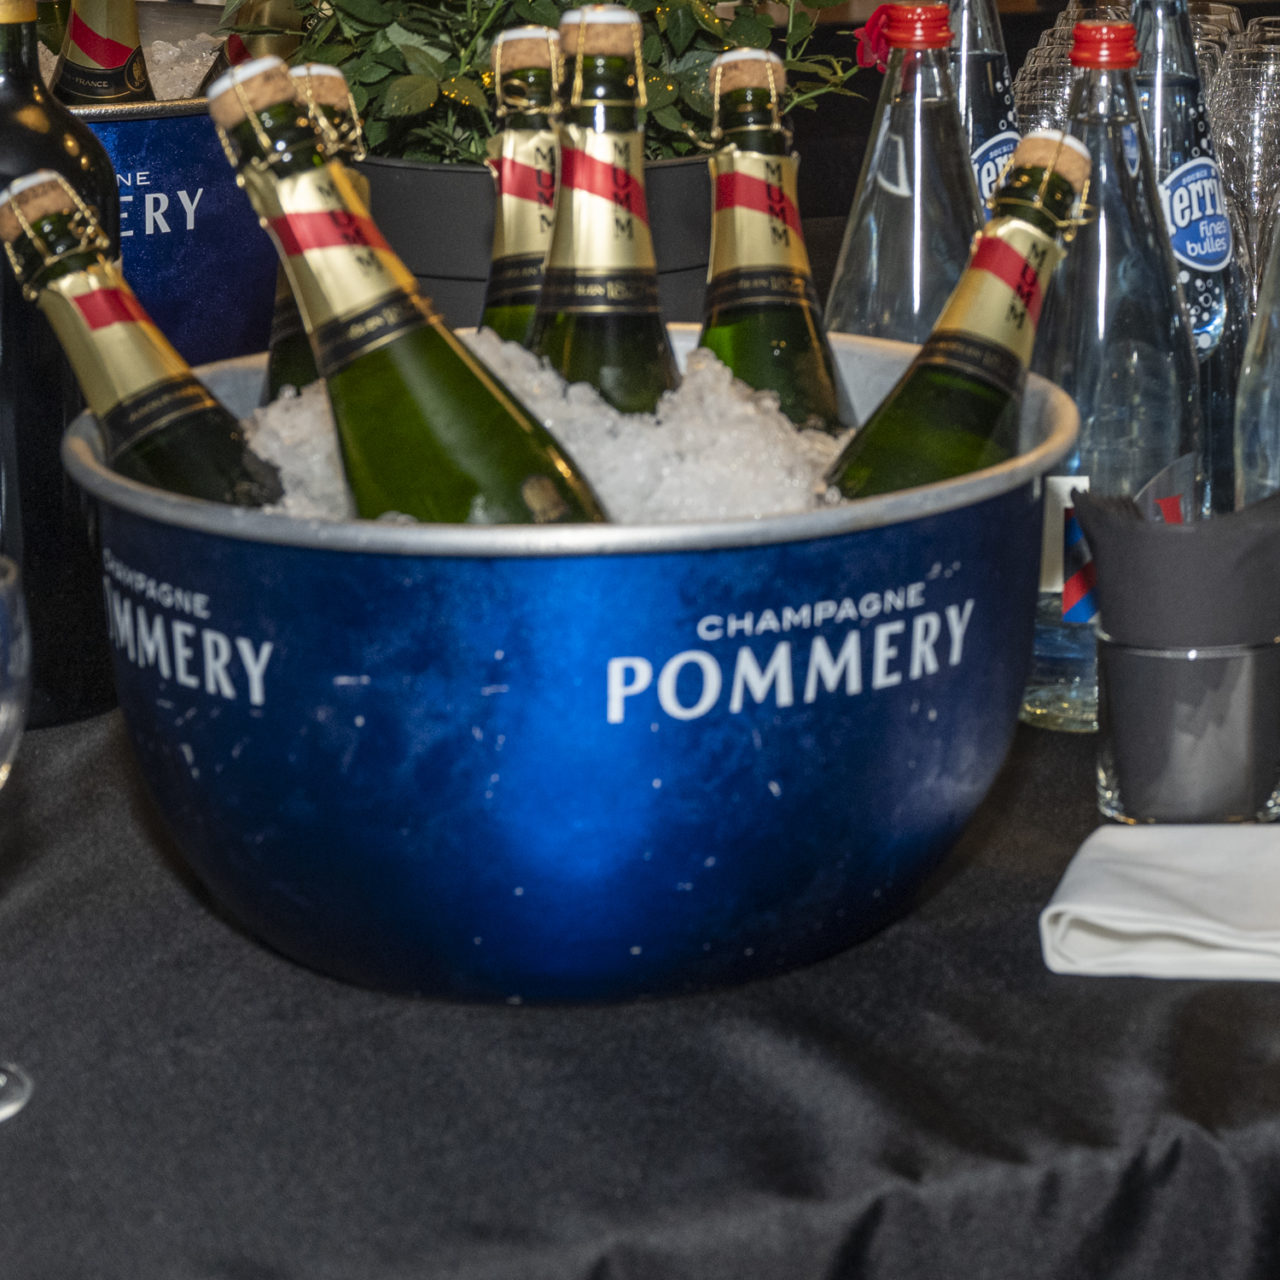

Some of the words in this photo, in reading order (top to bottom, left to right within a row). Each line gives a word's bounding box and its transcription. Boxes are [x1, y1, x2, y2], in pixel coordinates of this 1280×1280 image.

[1186, 236, 1227, 257] bulles
[696, 581, 926, 642] CHAMPAGNE
[605, 597, 975, 725] POMMERY
